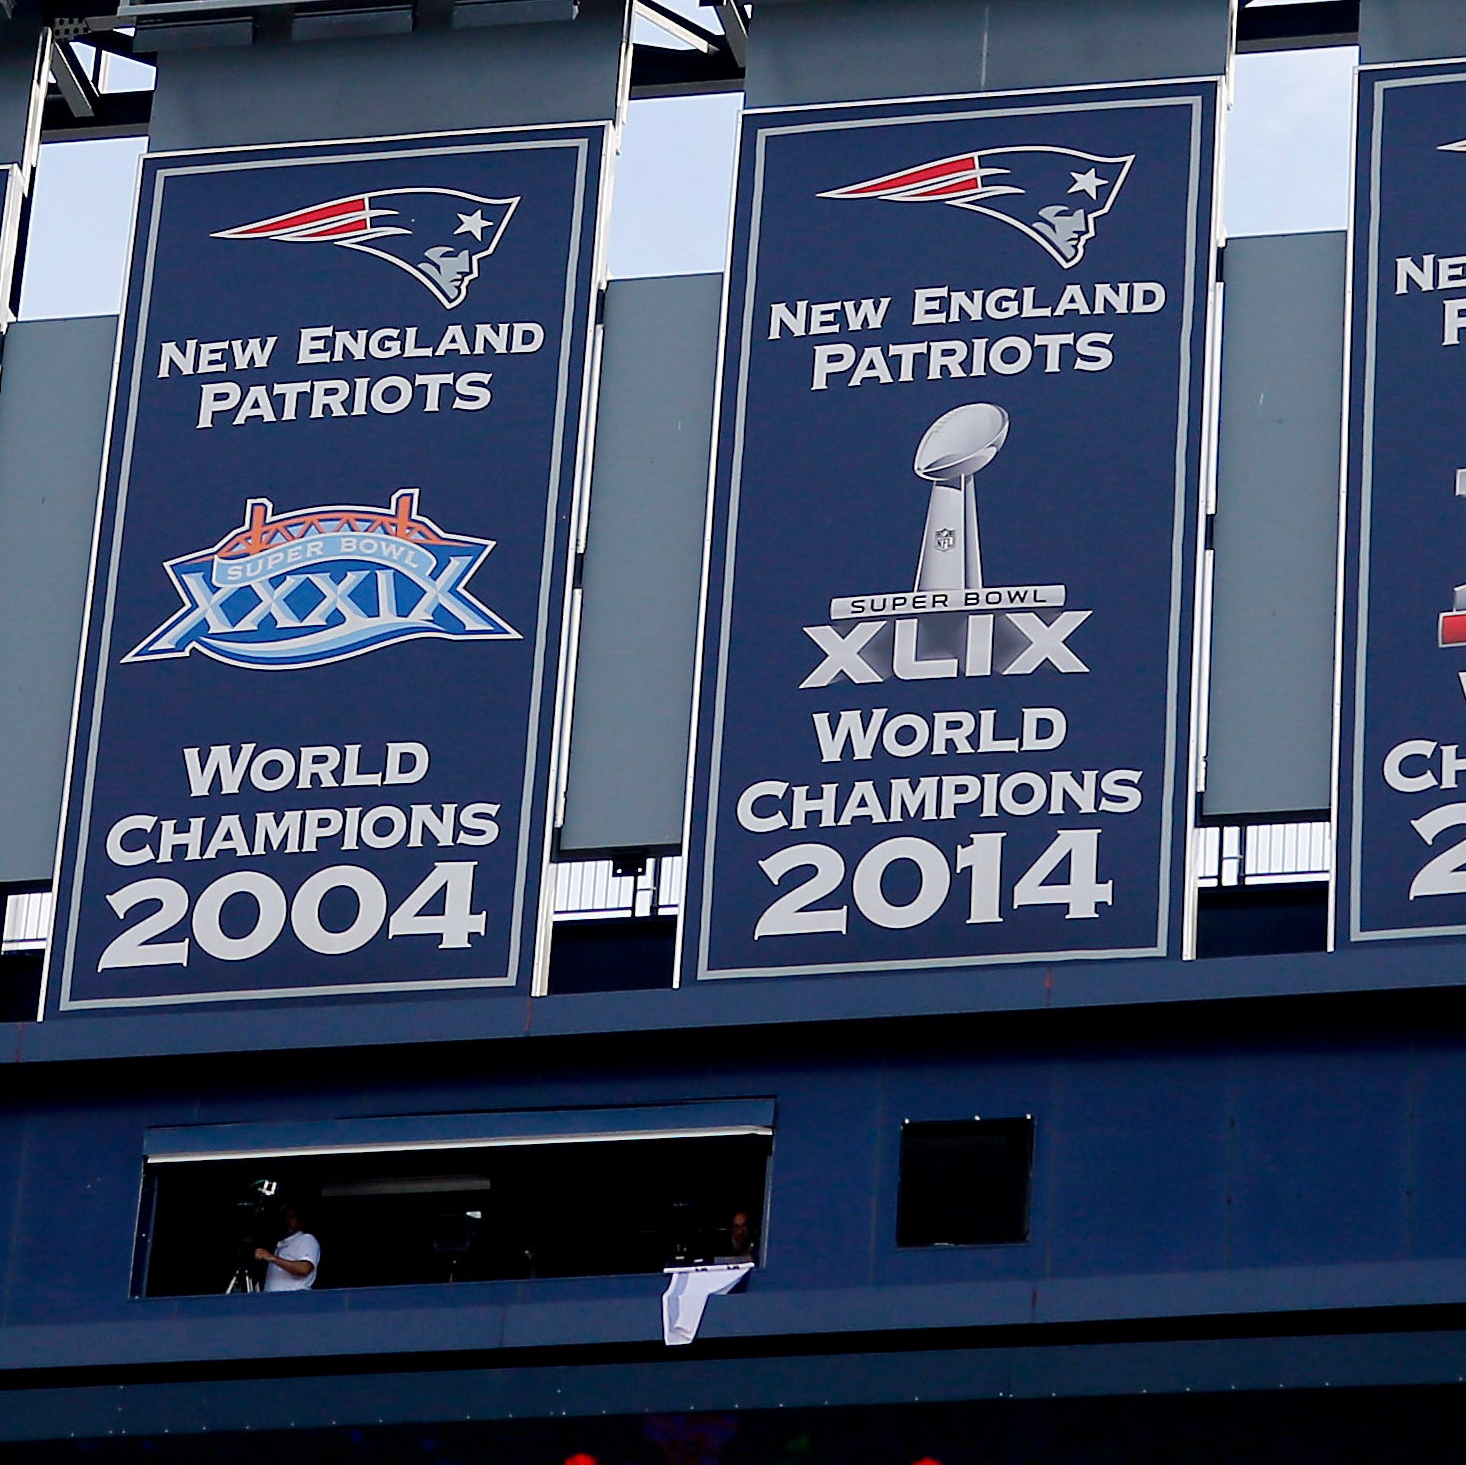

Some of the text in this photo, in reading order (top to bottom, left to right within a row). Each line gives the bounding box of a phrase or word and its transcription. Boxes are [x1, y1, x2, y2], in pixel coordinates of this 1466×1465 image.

[767, 282, 1166, 340] NEW ENGLAND
[157, 322, 545, 379] NEW ENGLAND
[810, 332, 1114, 391] PATRIOTS
[195, 371, 493, 429] PATRIOTS
[226, 537, 421, 582] SUPER BOWL
[147, 555, 496, 652] XXXIX
[850, 589, 1047, 615] SUPER BOWL
[798, 610, 1094, 689] XLIX
[812, 707, 1067, 763] WORLD
[183, 742, 429, 797] WORLD
[736, 769, 1143, 833] CHAMPIONS
[106, 802, 501, 866] CHAMPIONS
[754, 828, 1113, 941] 2014
[97, 861, 487, 973] 2004
